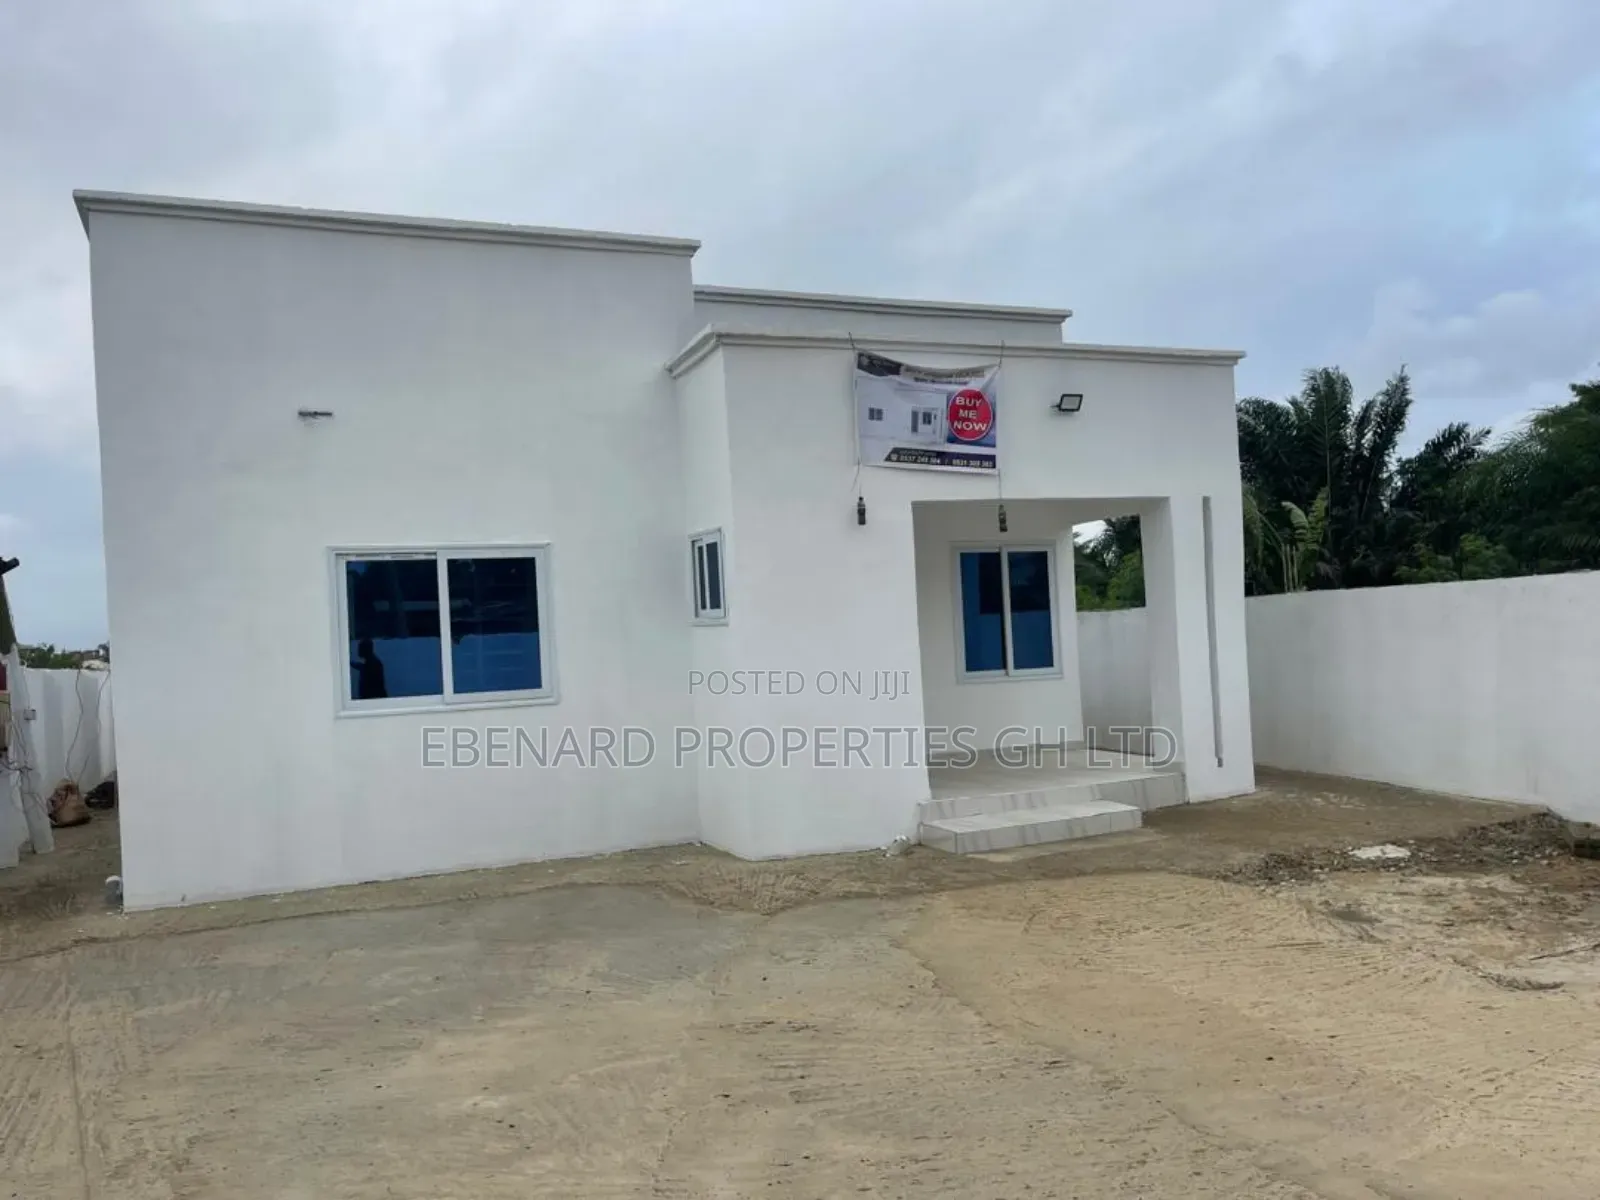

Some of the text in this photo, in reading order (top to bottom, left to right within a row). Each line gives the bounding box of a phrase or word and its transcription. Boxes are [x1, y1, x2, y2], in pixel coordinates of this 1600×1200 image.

[956, 396, 982, 407] BUY
[959, 409, 978, 419] ME
[953, 420, 987, 431] NOW
